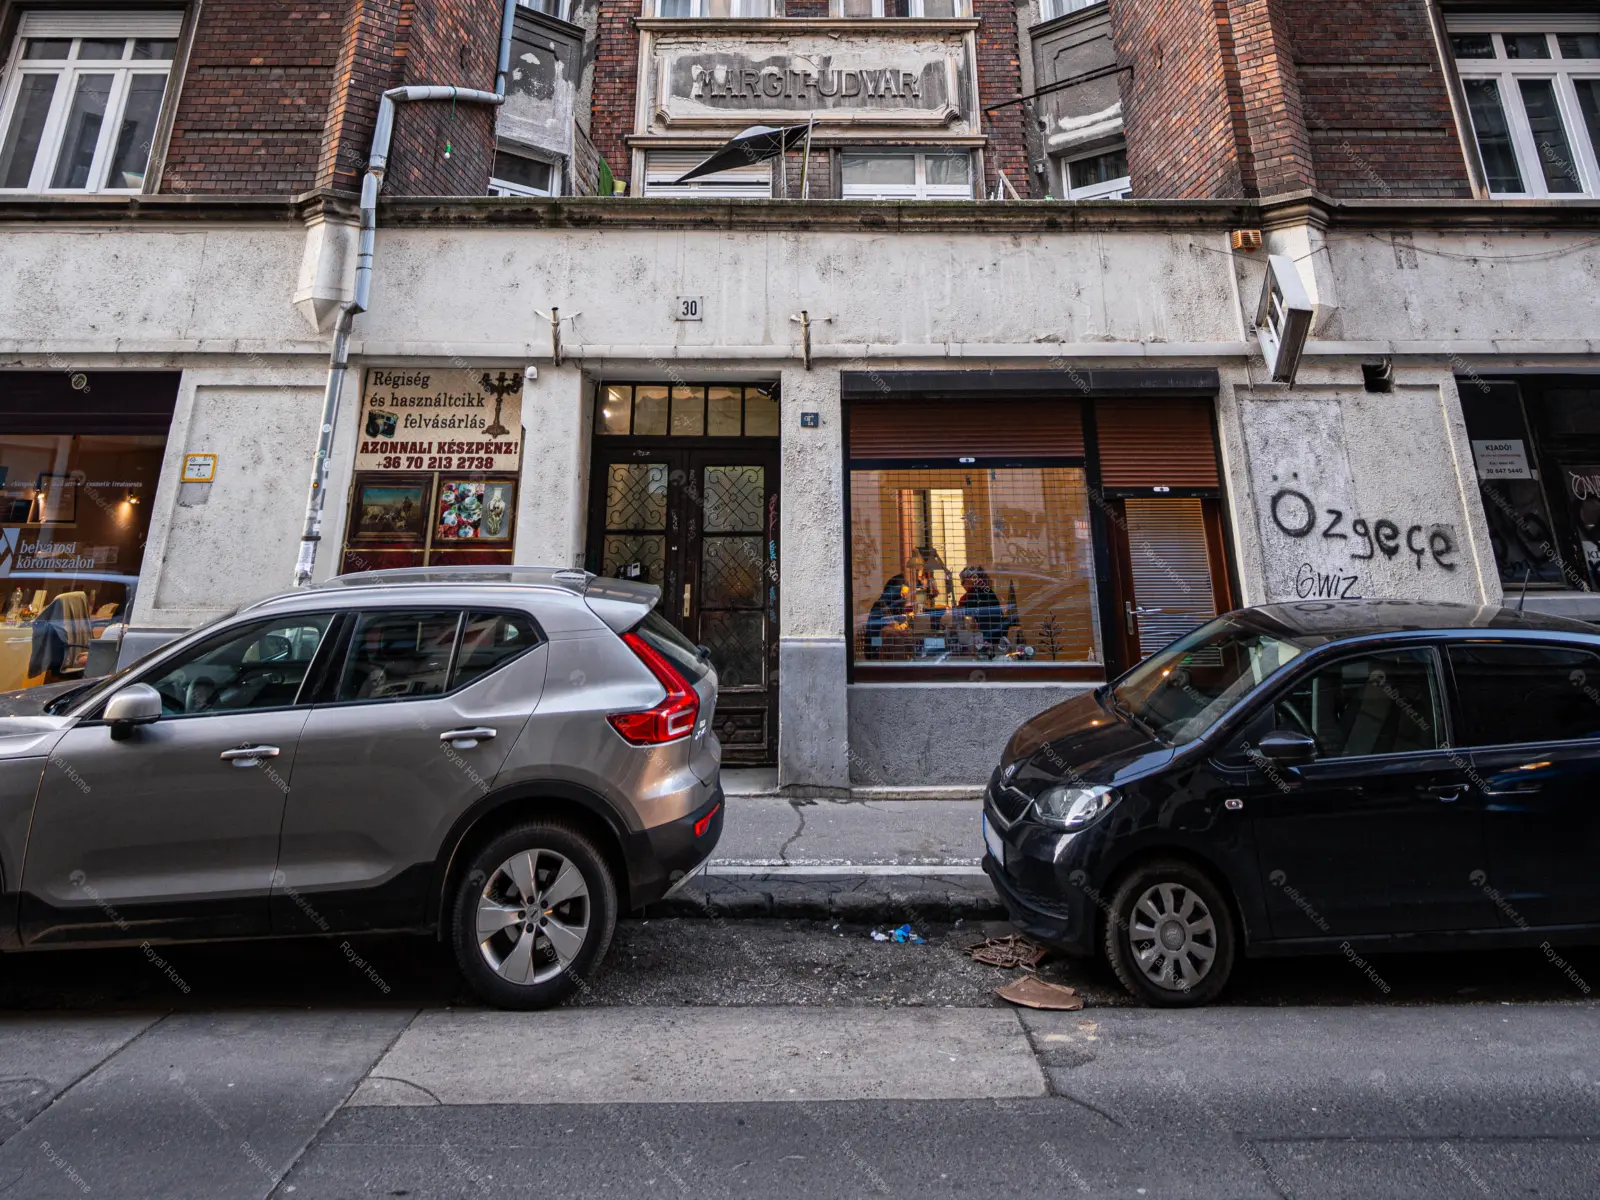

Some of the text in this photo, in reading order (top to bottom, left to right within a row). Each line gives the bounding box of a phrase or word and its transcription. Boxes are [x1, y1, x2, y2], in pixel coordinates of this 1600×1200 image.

[682, 300, 697, 317] 30
[373, 371, 430, 388] Régiség
[370, 392, 485, 408] és használtcikk
[403, 413, 486, 429] felvásárlás
[360, 438, 518, 455] AZONNALI KÉSZPÉNZ!
[1485, 443, 1512, 451] KIADÓ!
[375, 456, 494, 469] +36 70 213 2738
[20, 540, 76, 554] belvárosi
